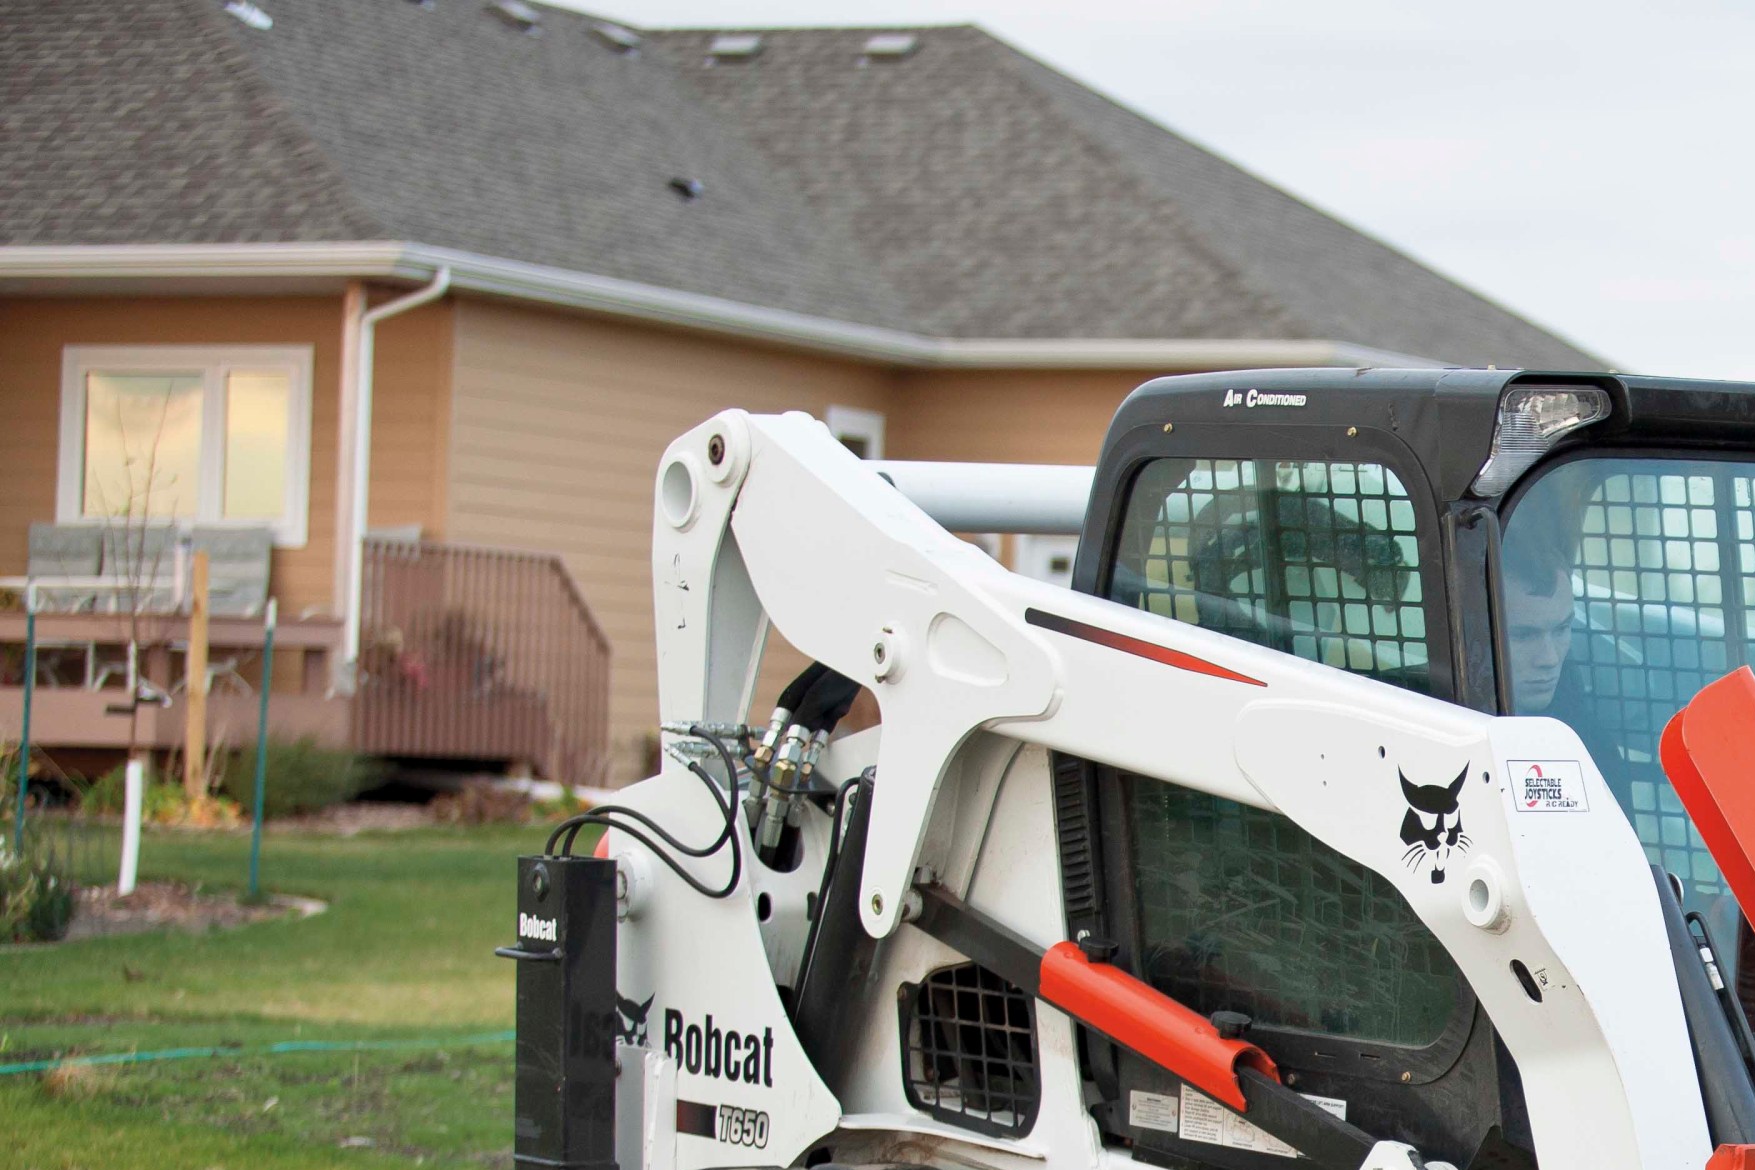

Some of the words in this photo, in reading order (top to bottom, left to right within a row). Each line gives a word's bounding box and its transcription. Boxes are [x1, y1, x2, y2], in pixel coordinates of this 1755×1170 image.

[1525, 778, 1561, 787] SELECTABLE
[1525, 788, 1562, 800] JOYSTICKS
[519, 912, 557, 941] Bobcat
[665, 1008, 774, 1088] Bobcat
[719, 1104, 770, 1148] T650
